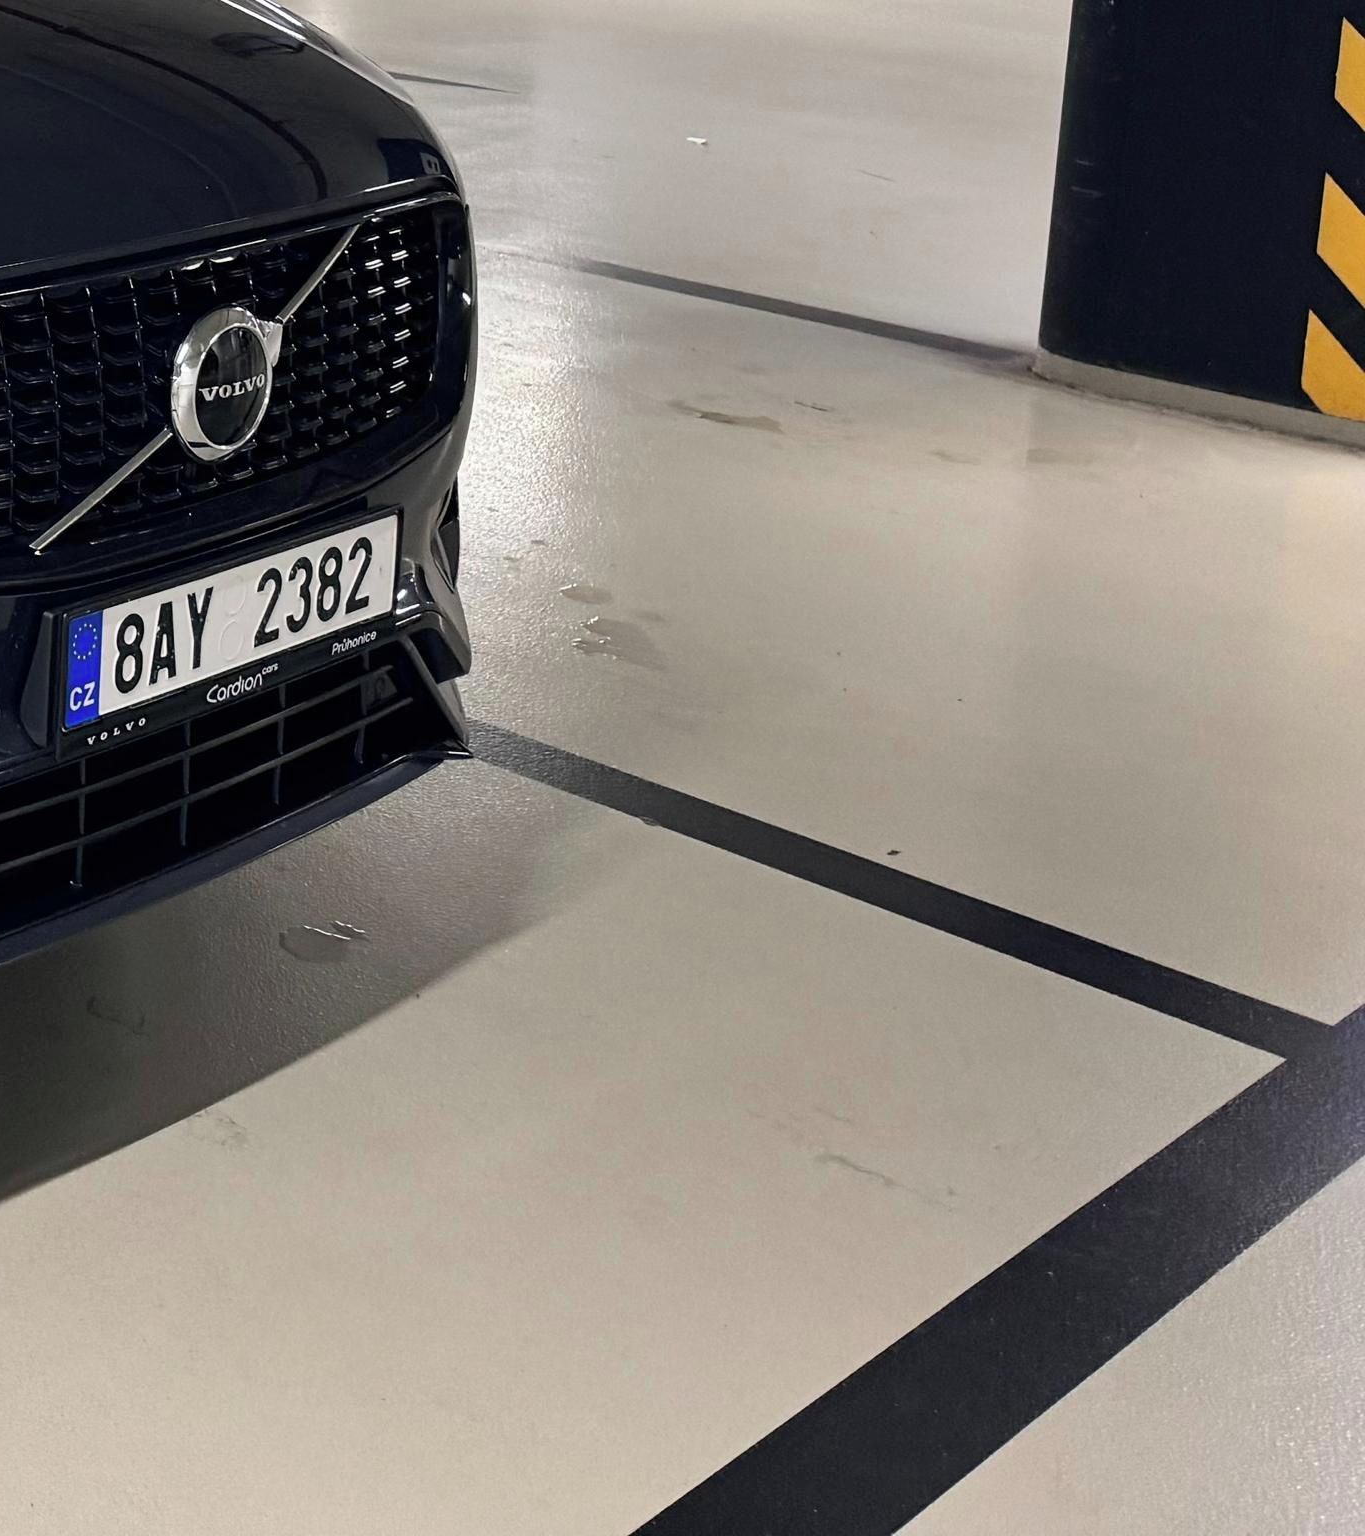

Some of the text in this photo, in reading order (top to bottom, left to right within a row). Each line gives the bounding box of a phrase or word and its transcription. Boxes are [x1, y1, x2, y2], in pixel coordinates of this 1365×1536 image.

[198, 373, 266, 402] VOLVO
[114, 536, 373, 695] 8AY 2382
[331, 630, 377, 656] Průhonice
[69, 680, 96, 712] CZ
[206, 671, 263, 704] Cardion
[86, 717, 147, 746] VOLVO
